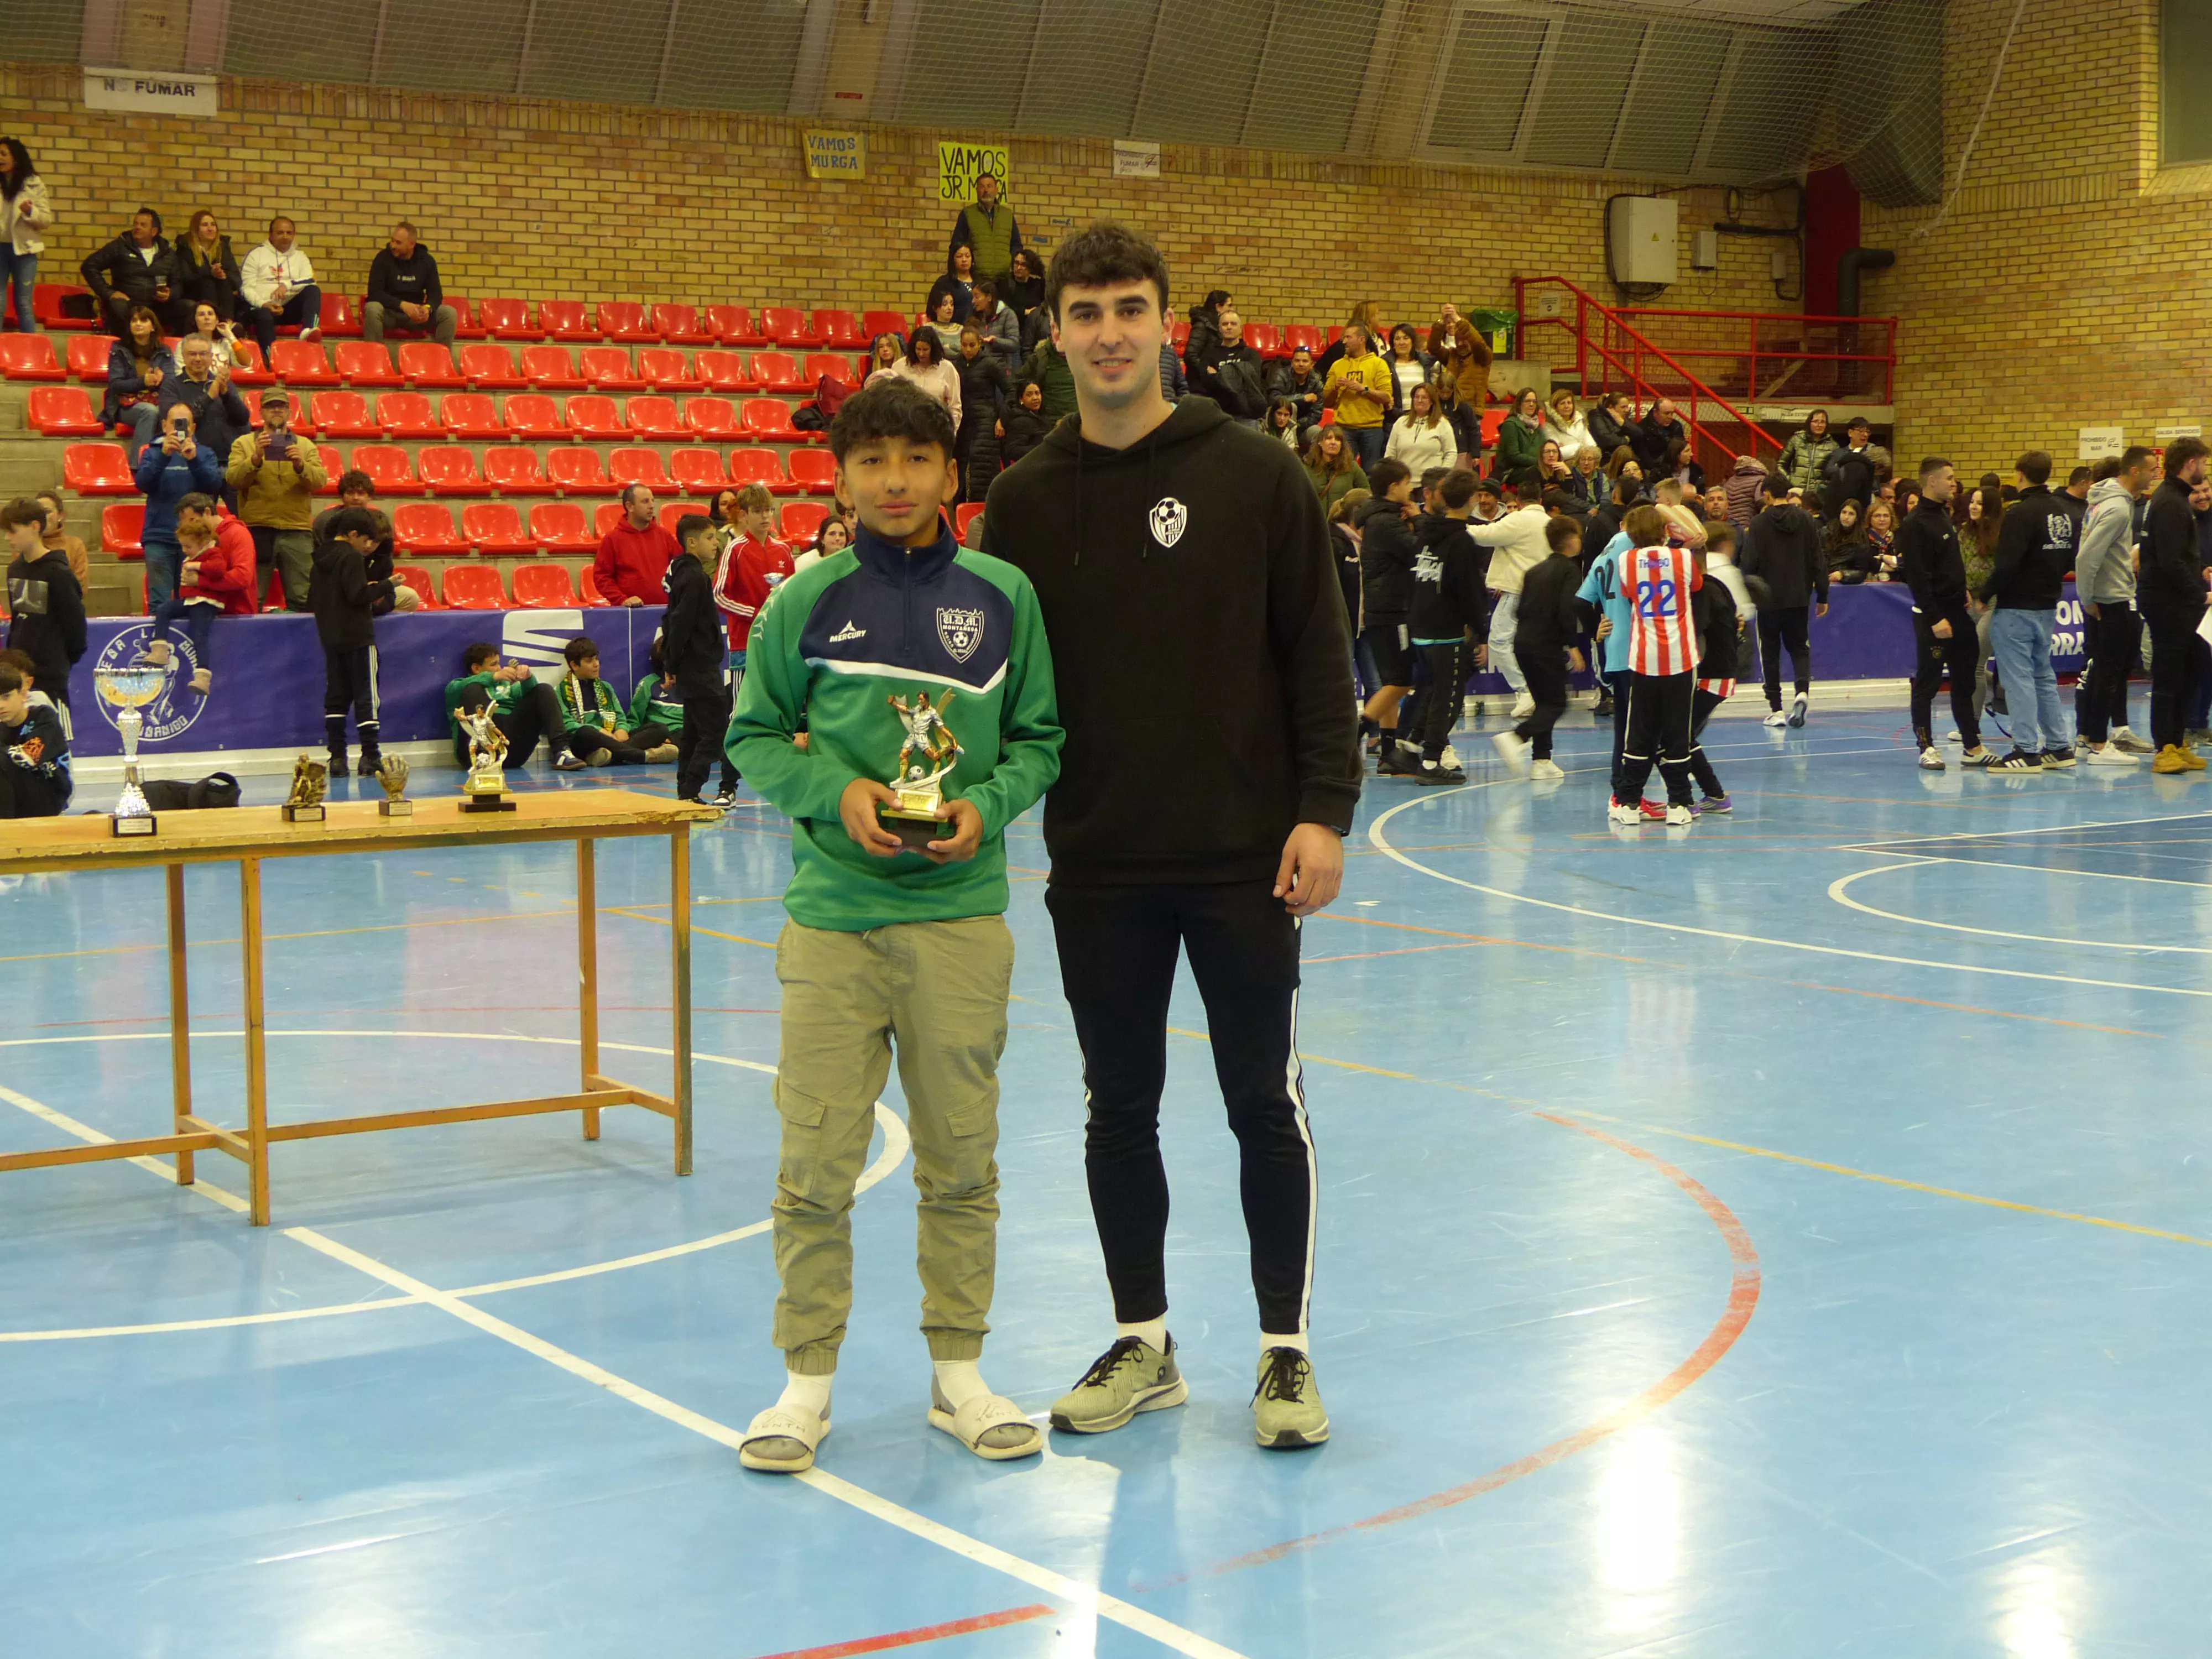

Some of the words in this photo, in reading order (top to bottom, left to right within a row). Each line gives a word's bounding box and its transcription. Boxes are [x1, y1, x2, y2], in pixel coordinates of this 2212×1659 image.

[134, 80, 196, 97] FUMAR
[808, 135, 856, 151] VAMOS
[811, 154, 858, 170] MURGA
[941, 147, 1006, 178] VAMOS
[942, 175, 966, 200] JR.
[1638, 557, 1670, 568] THGO
[1637, 580, 1677, 618] 22
[830, 629, 867, 643] MERCURY
